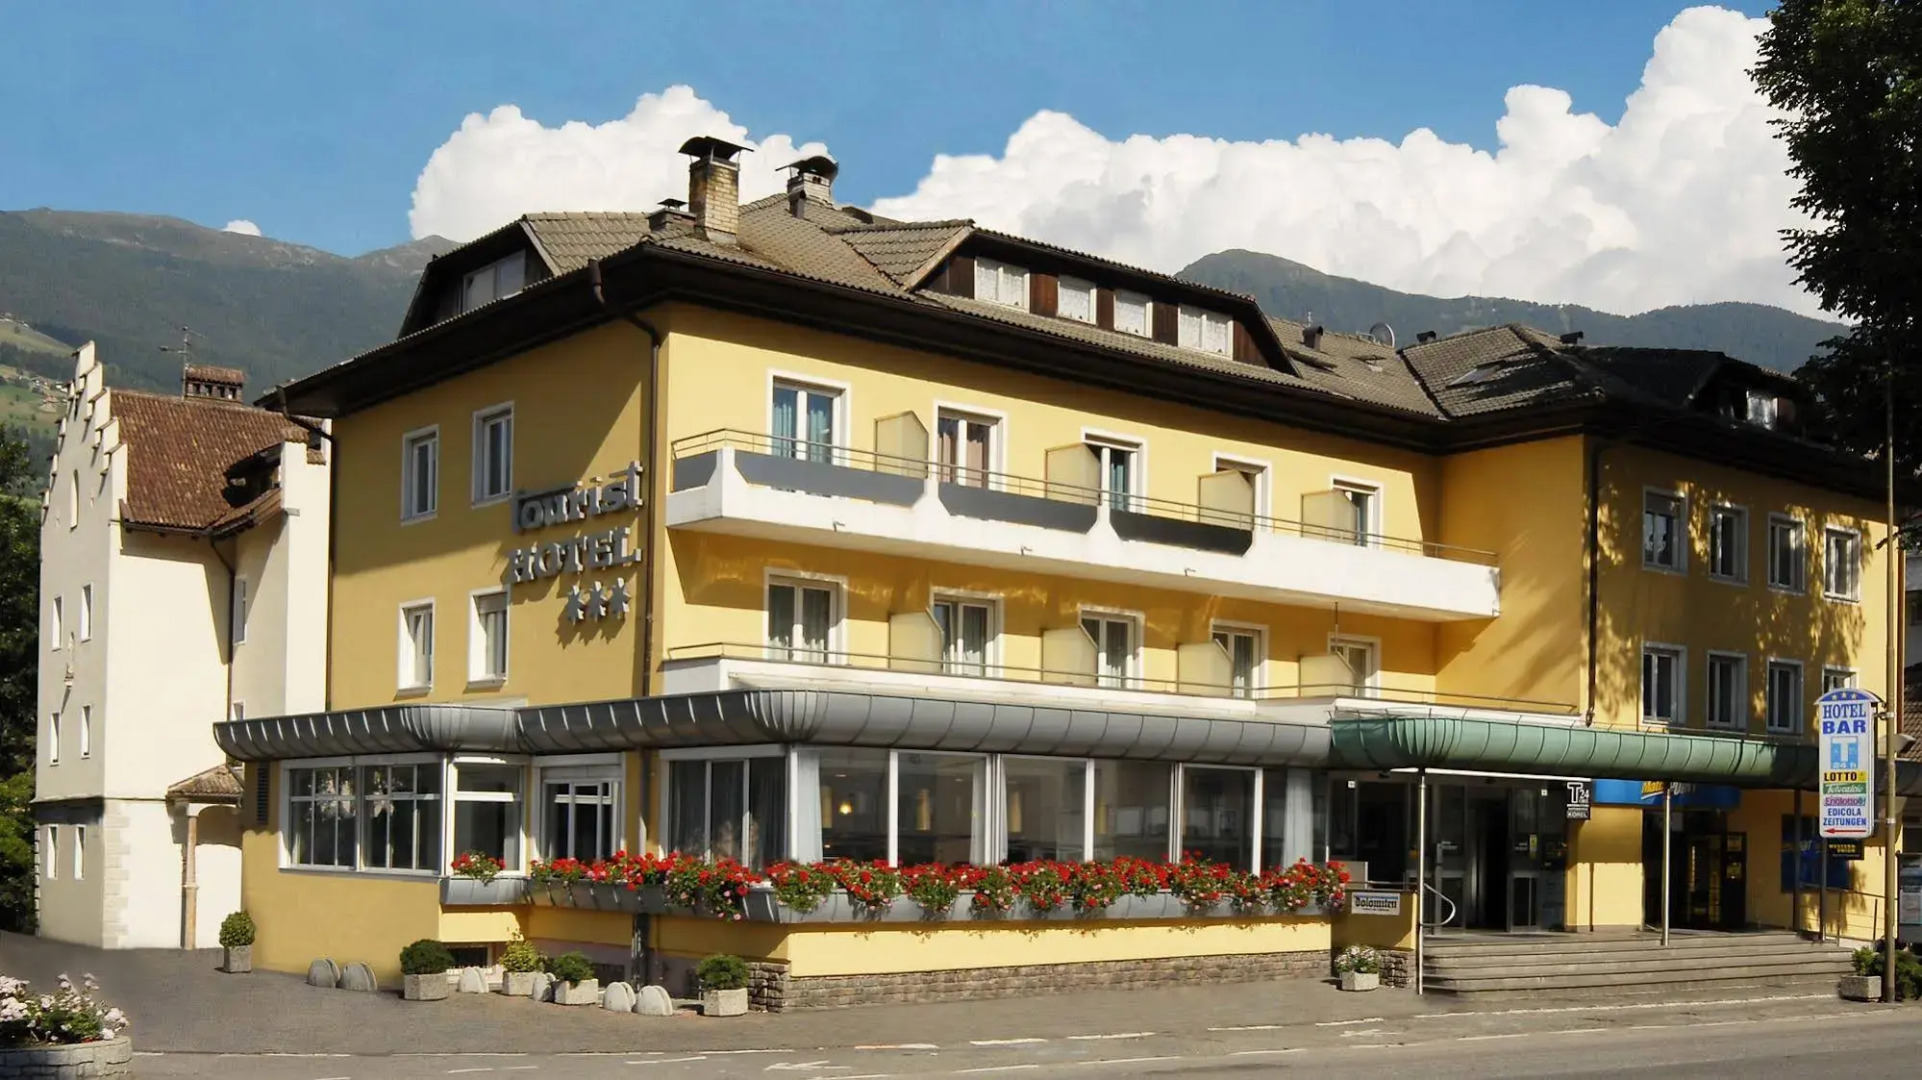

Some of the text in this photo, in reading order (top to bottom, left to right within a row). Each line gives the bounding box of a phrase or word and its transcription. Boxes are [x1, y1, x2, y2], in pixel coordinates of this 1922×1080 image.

[508, 527, 642, 583] HOTEL
[1823, 703, 1867, 719] HOTEL
[1822, 719, 1867, 735] BAR
[1824, 771, 1858, 781] LOTTO
[1580, 789, 1590, 799] 24
[1827, 807, 1862, 816] EDICOLA
[1823, 817, 1867, 826] ZEITUNGEN
